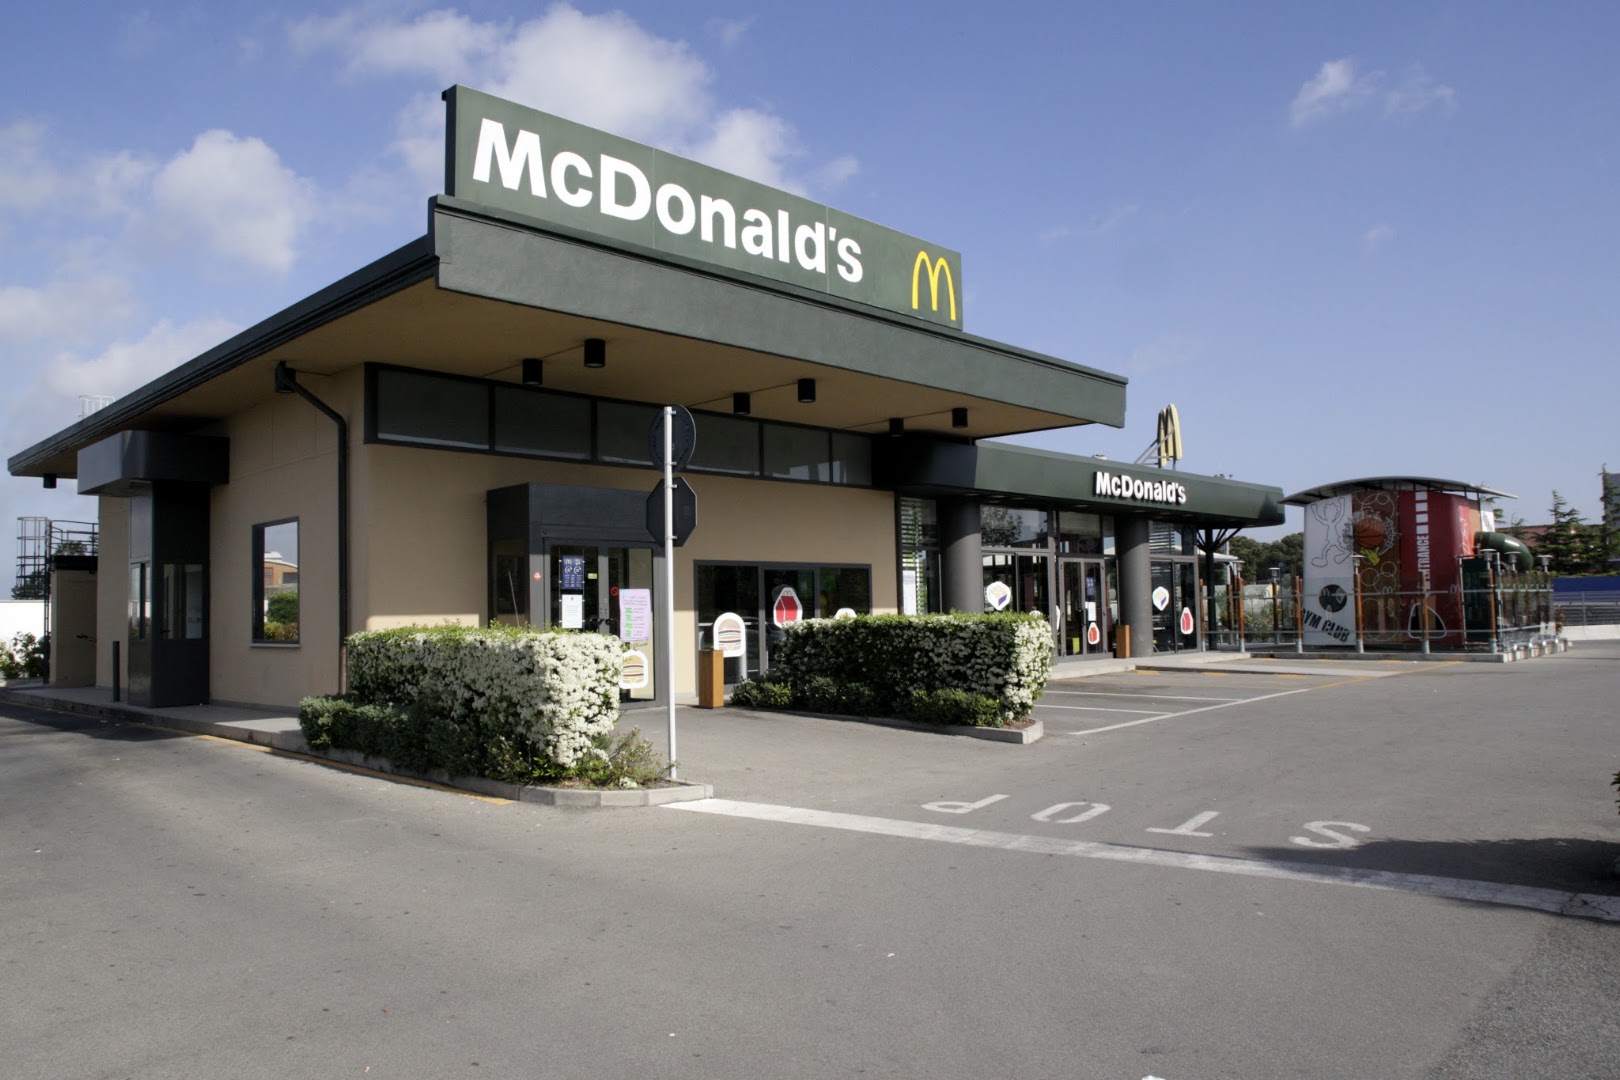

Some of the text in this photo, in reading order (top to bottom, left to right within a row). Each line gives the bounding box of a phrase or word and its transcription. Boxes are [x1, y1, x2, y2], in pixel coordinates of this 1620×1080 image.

[473, 118, 863, 283] McDonald's
[1095, 471, 1187, 504] McDonald's
[1321, 619, 1350, 643] CLUB
[920, 794, 1372, 850] STOP
